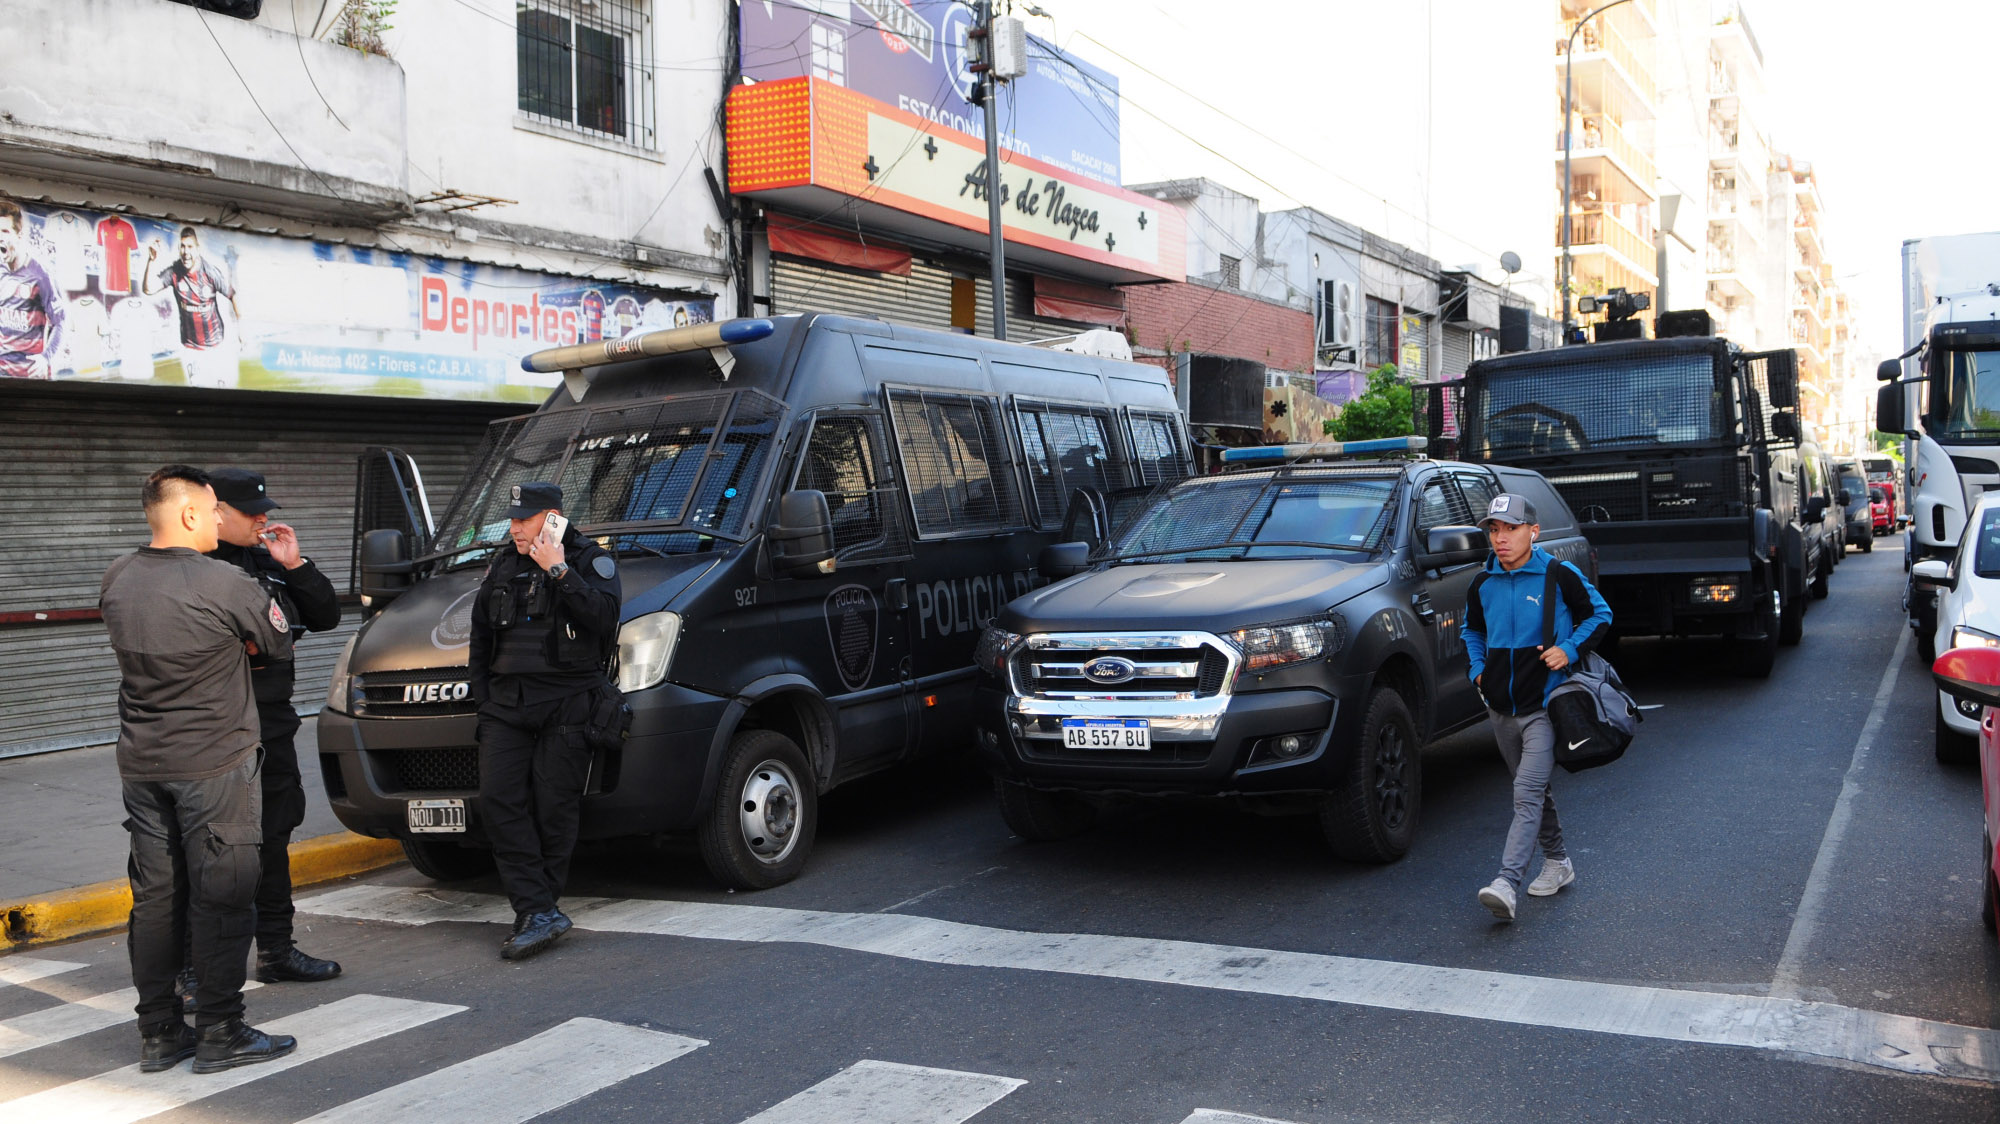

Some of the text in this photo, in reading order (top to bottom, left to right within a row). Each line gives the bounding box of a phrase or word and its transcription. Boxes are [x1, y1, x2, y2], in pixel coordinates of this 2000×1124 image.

[861, 0, 930, 51] UTLET
[898, 94, 1031, 157] ESTACIONAENTO
[1016, 178, 1039, 216] de
[1044, 180, 1100, 241] Nazca
[421, 273, 578, 351] Deportes
[276, 348, 297, 367] Av.
[301, 350, 342, 369] Nazca
[345, 353, 368, 370] 402
[378, 355, 416, 373] Flores
[427, 358, 474, 377] C.A.B.A.
[734, 586, 758, 607] 927
[835, 589, 866, 609] POLICIA
[916, 573, 1009, 640] POLICIA
[1093, 663, 1120, 677] Ford
[402, 681, 469, 704] IVECO
[1068, 729, 1145, 747] AB 557 BU
[409, 806, 464, 828] NOU 111
